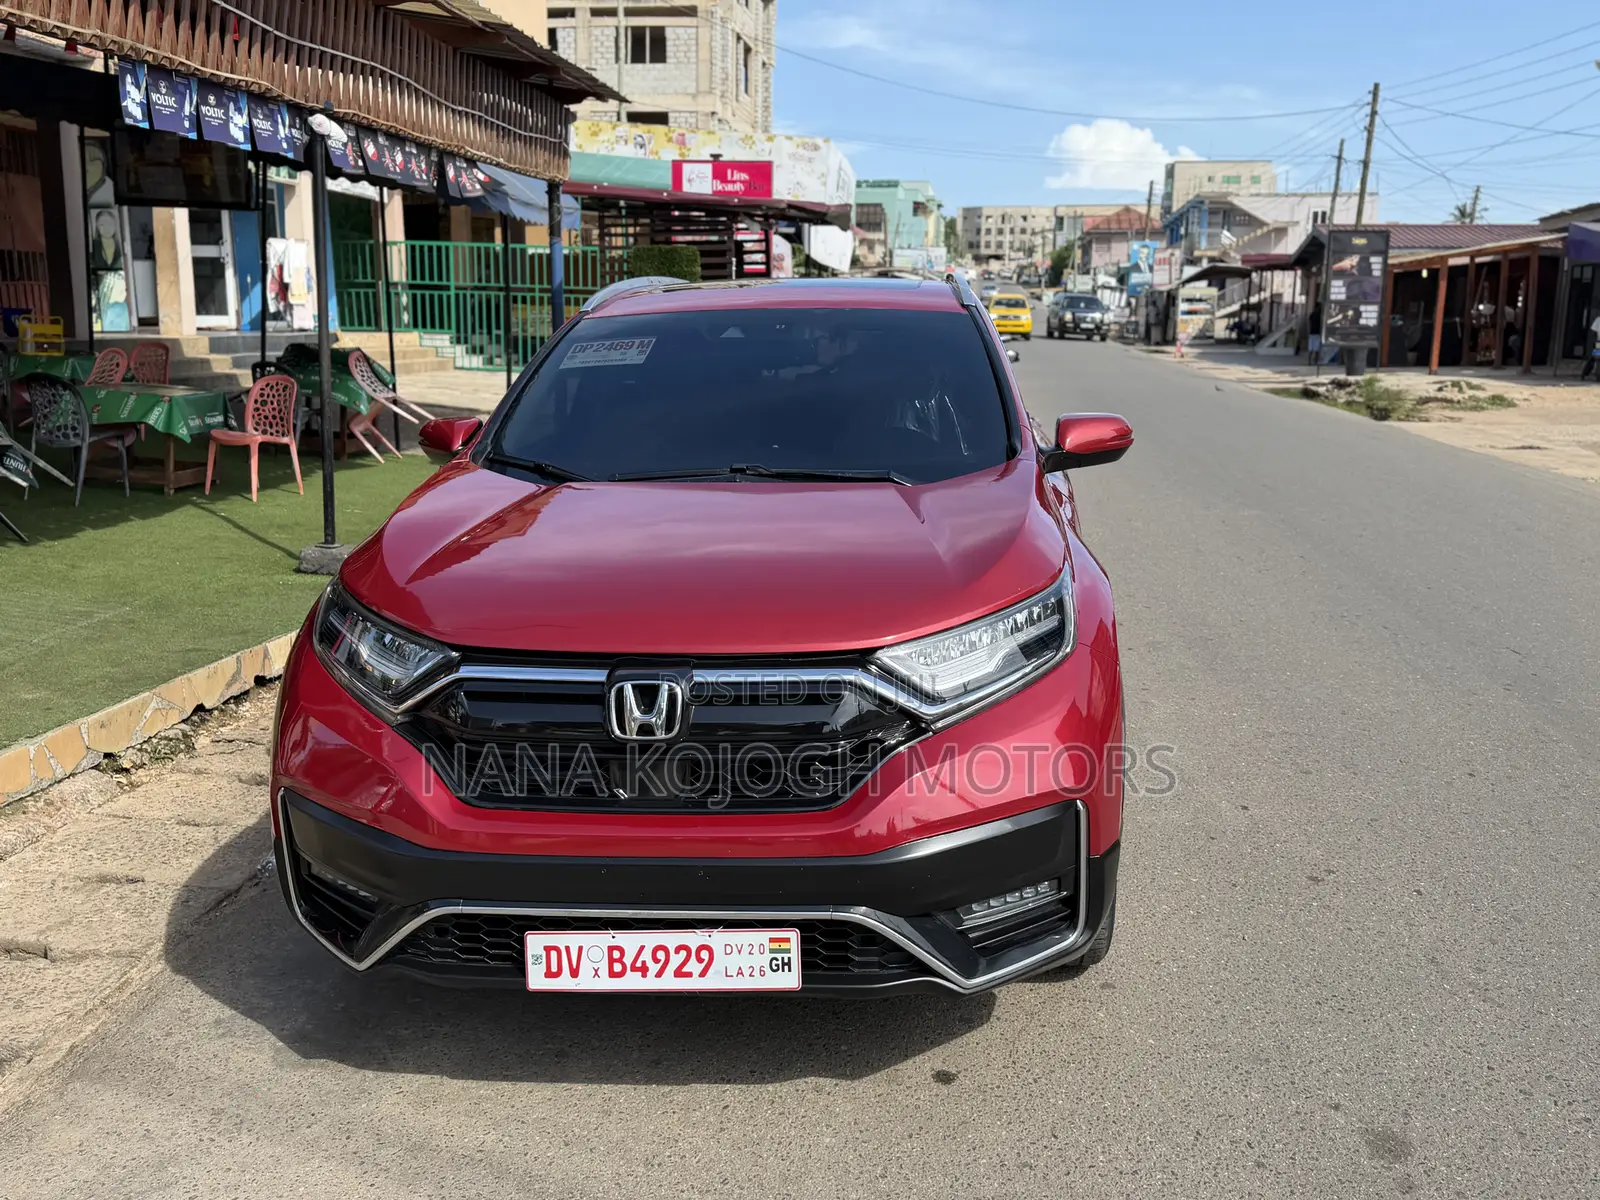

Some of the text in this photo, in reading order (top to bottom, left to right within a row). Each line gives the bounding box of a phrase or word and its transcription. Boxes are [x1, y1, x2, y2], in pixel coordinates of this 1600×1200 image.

[150, 92, 178, 108] VOLTIC
[200, 105, 227, 120] VOLTIC
[712, 179, 745, 195] Beauty
[543, 945, 583, 979] DV
[607, 944, 715, 979] B4929
[768, 956, 792, 973] GH
